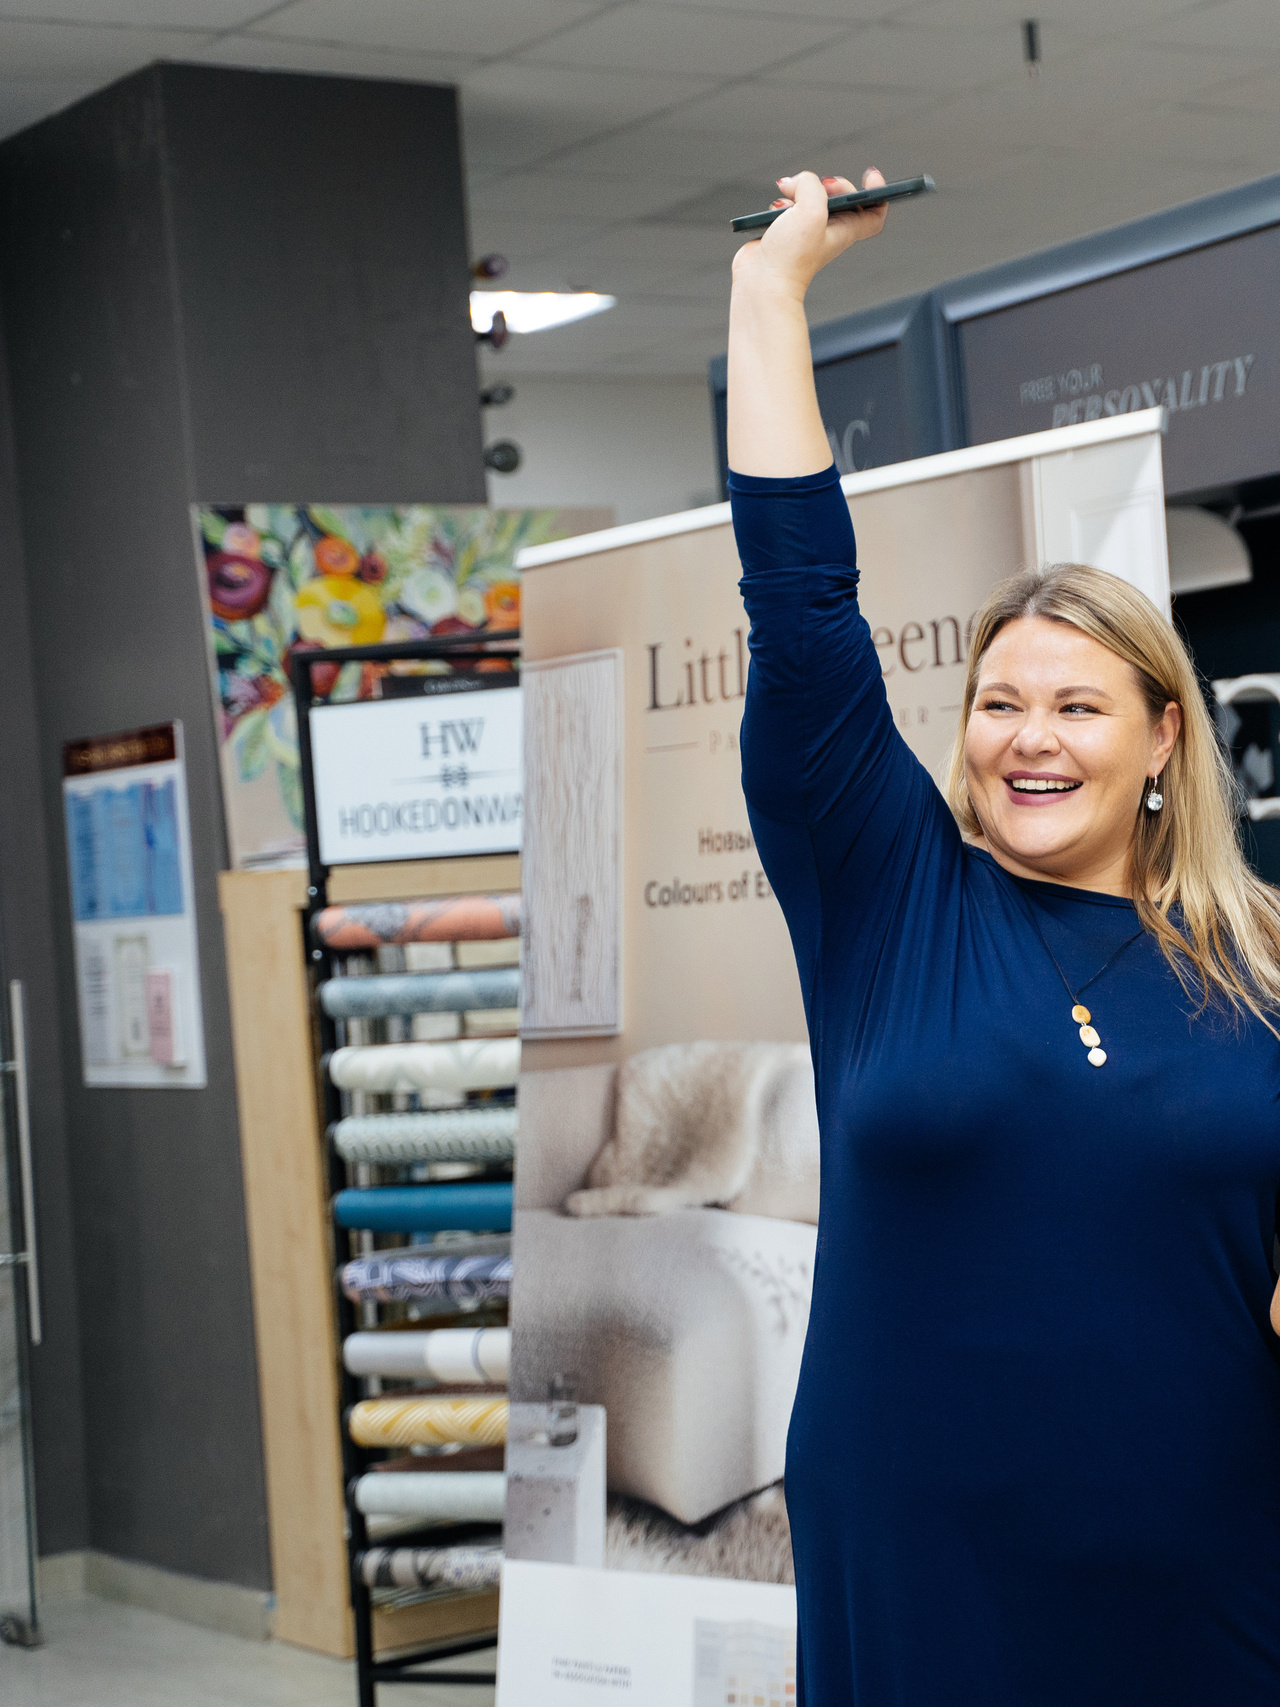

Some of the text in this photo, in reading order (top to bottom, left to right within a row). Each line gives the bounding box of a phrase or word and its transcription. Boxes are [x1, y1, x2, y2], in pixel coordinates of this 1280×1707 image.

[1052, 353, 1253, 429] PERSONALITY
[1058, 362, 1104, 396] YOUR
[645, 627, 745, 712] Littl
[420, 716, 486, 758] HW
[644, 876, 723, 908] Colours
[728, 870, 748, 902] of
